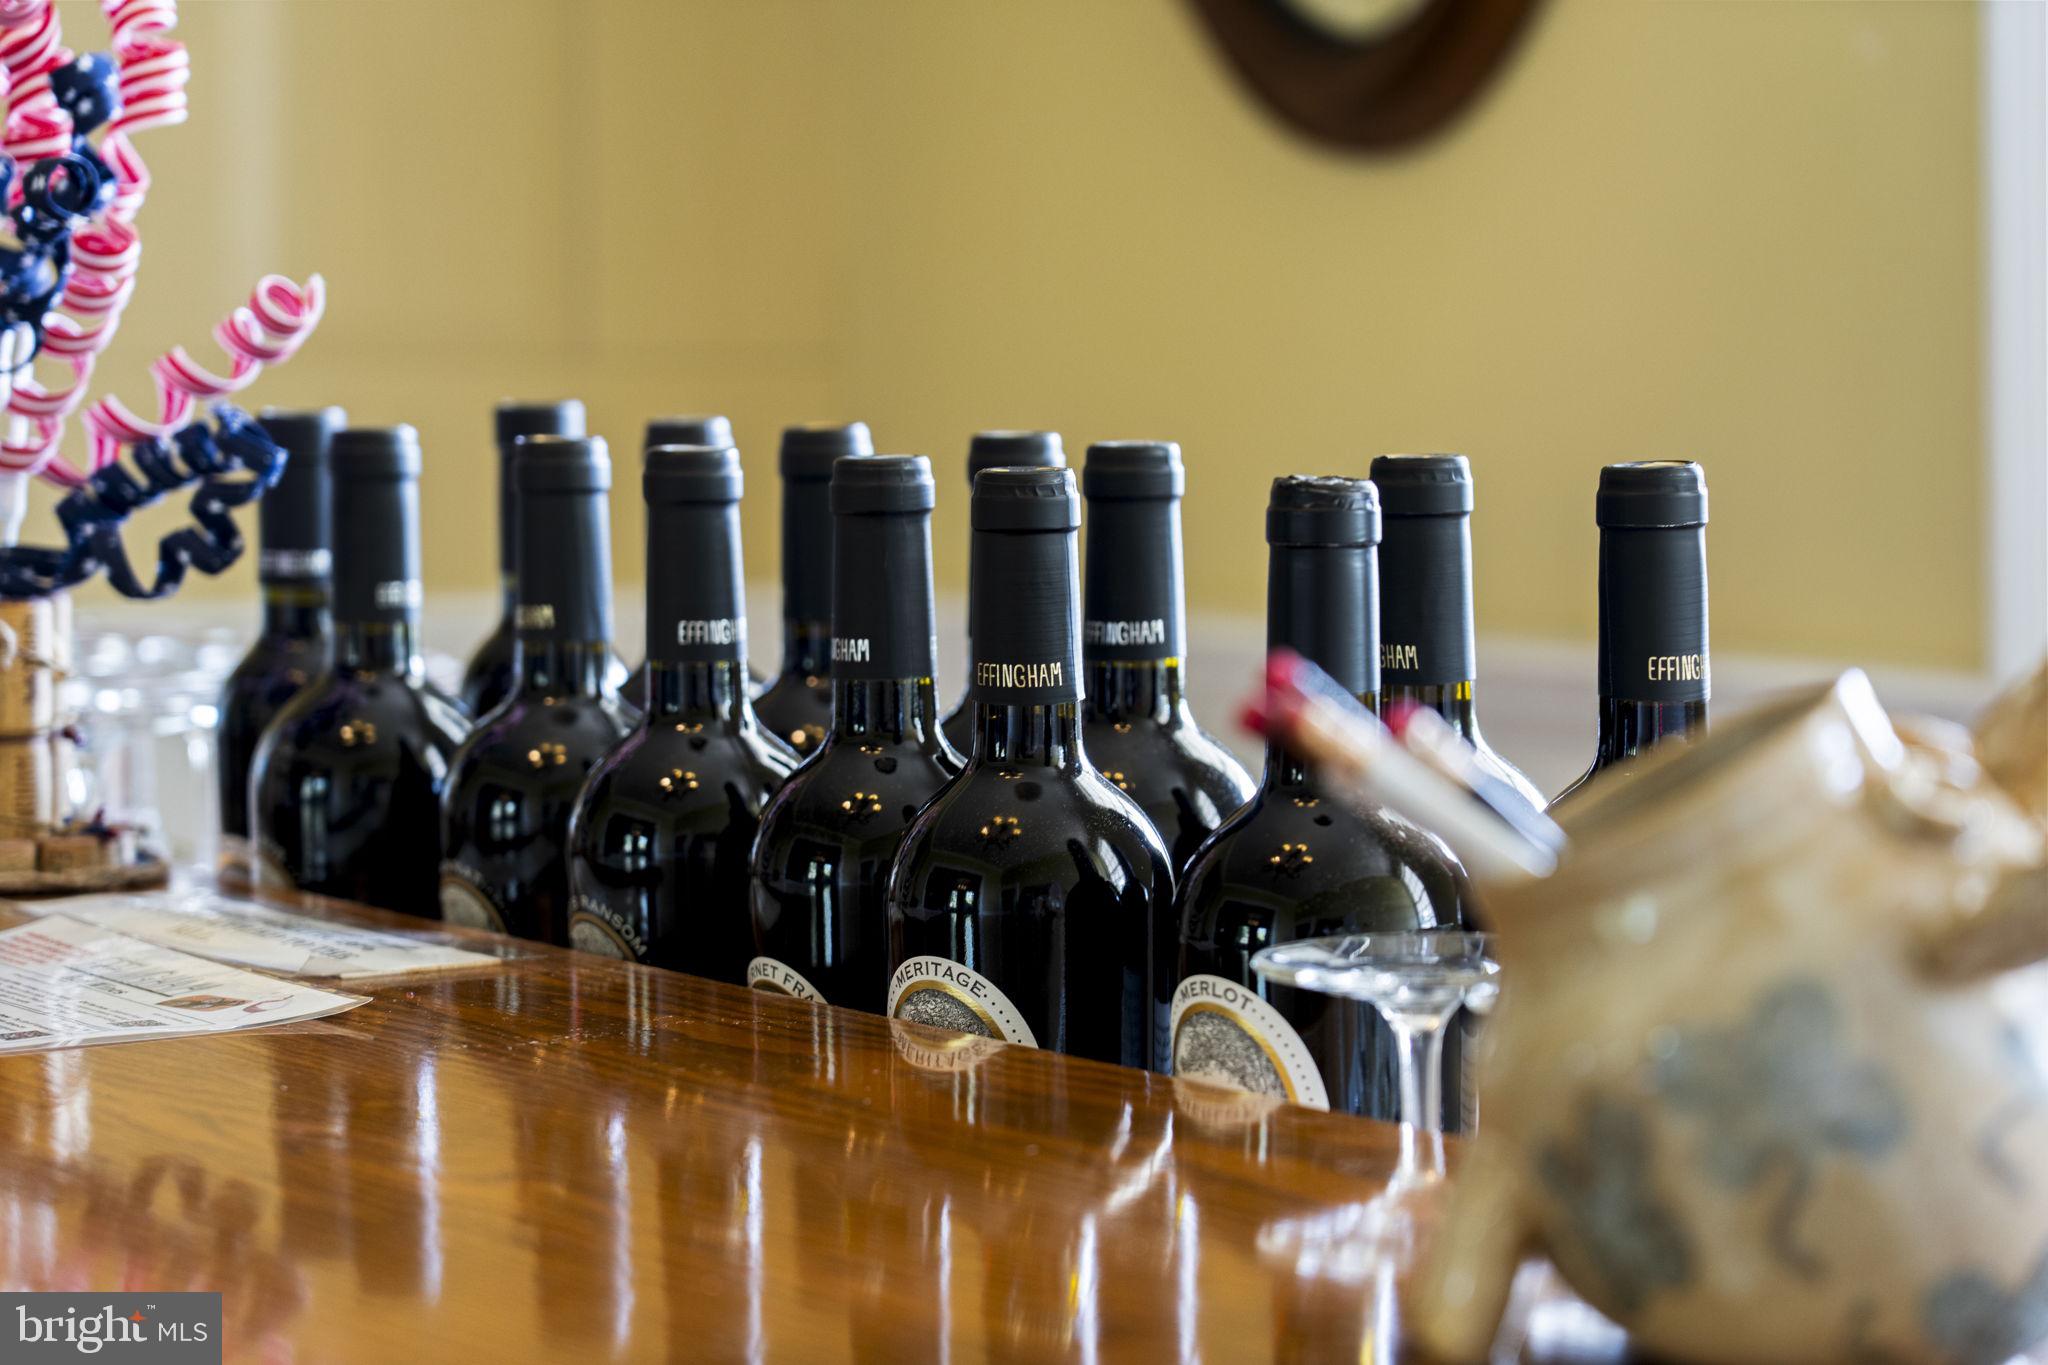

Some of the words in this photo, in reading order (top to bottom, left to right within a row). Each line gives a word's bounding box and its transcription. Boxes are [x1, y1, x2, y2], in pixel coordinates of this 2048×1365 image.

[978, 661, 1063, 688] EFFINGHAM
[896, 961, 987, 999] MERITAGE
[1180, 980, 1254, 1011] MERLOT
